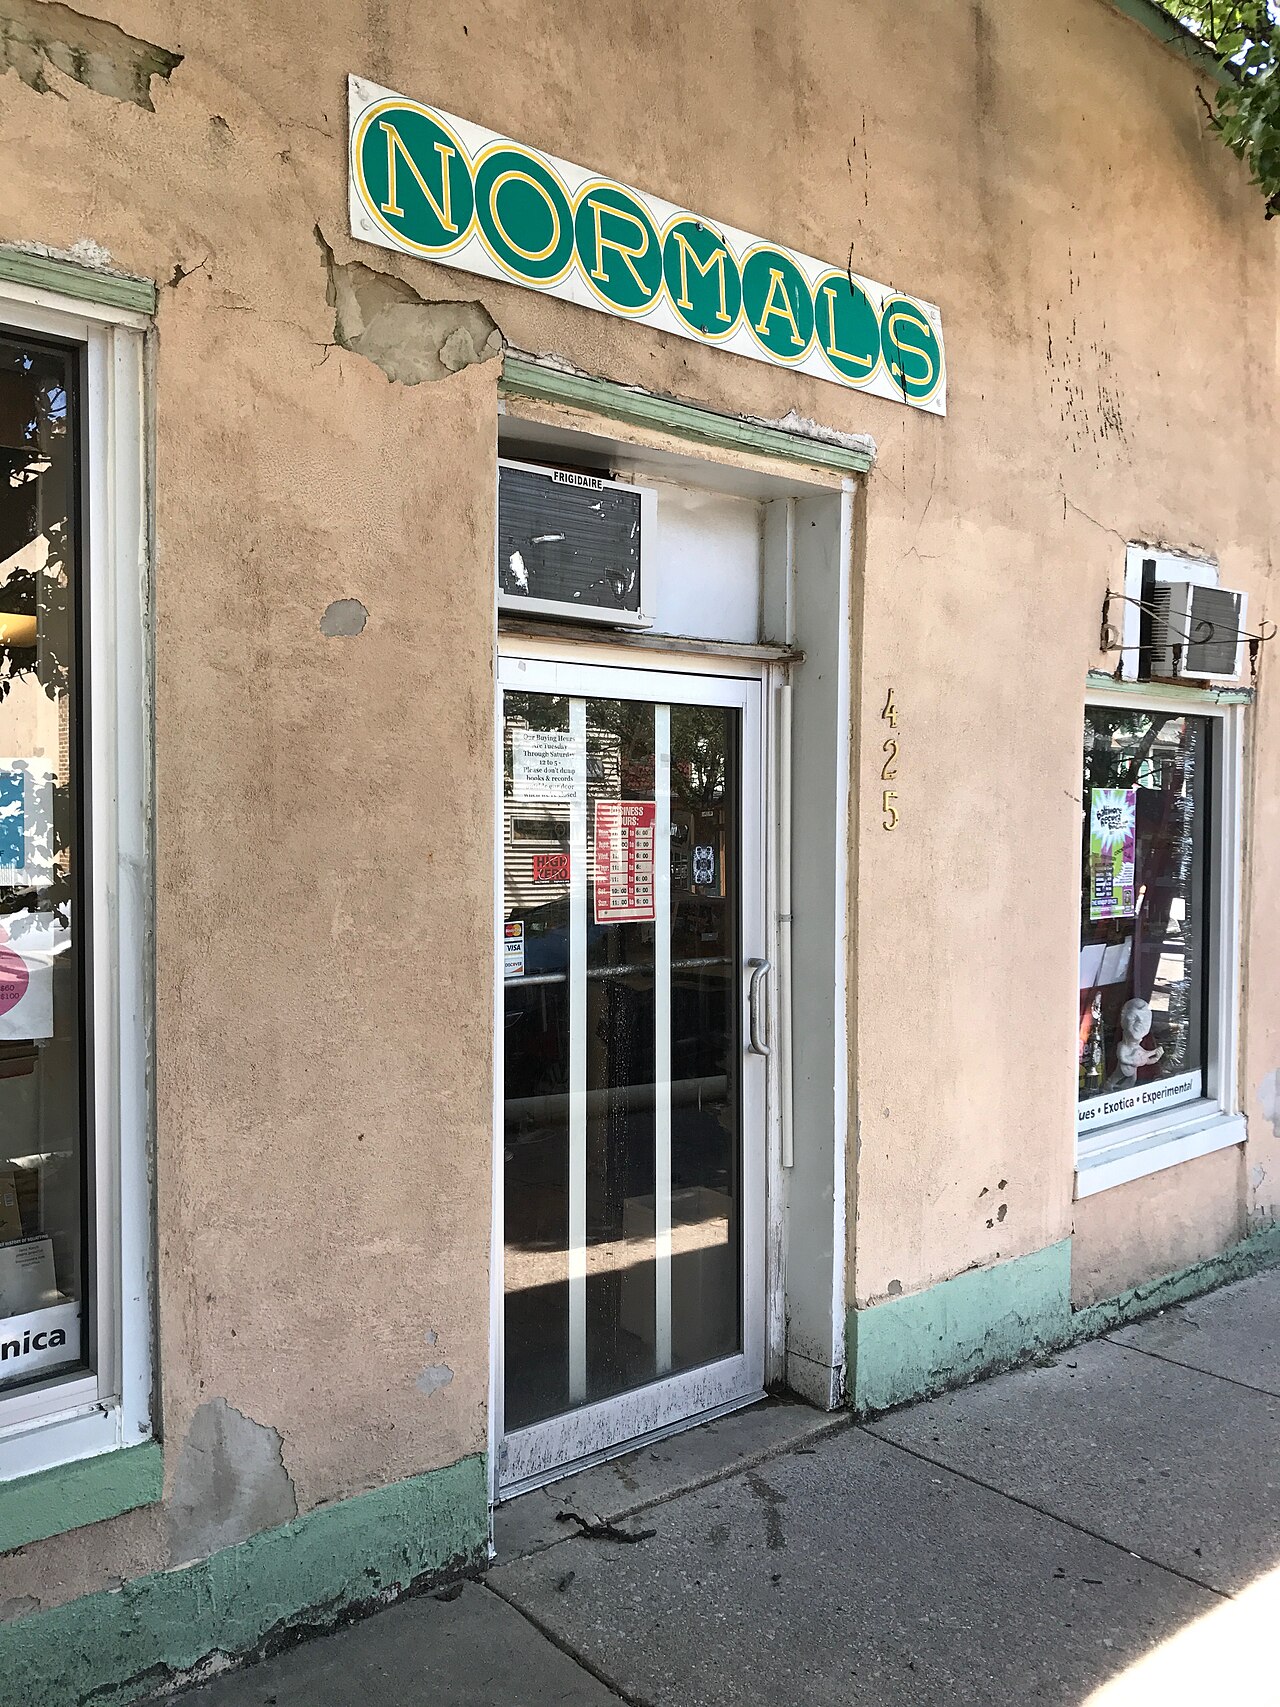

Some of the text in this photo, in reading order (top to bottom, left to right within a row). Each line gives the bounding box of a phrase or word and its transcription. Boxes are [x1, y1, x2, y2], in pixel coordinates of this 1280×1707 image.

[377, 120, 932, 387] NORMALS
[553, 471, 603, 490] FRIGIDAIRE
[537, 734, 557, 742] Buying
[523, 750, 549, 758] Through
[881, 687, 899, 831] 425
[560, 767, 576, 775] dump
[537, 857, 567, 867] HIGH
[538, 868, 568, 880] ZERO
[507, 944, 521, 952] VISA
[1104, 1098, 1135, 1115] Exotica
[1142, 1079, 1193, 1104] Experimental
